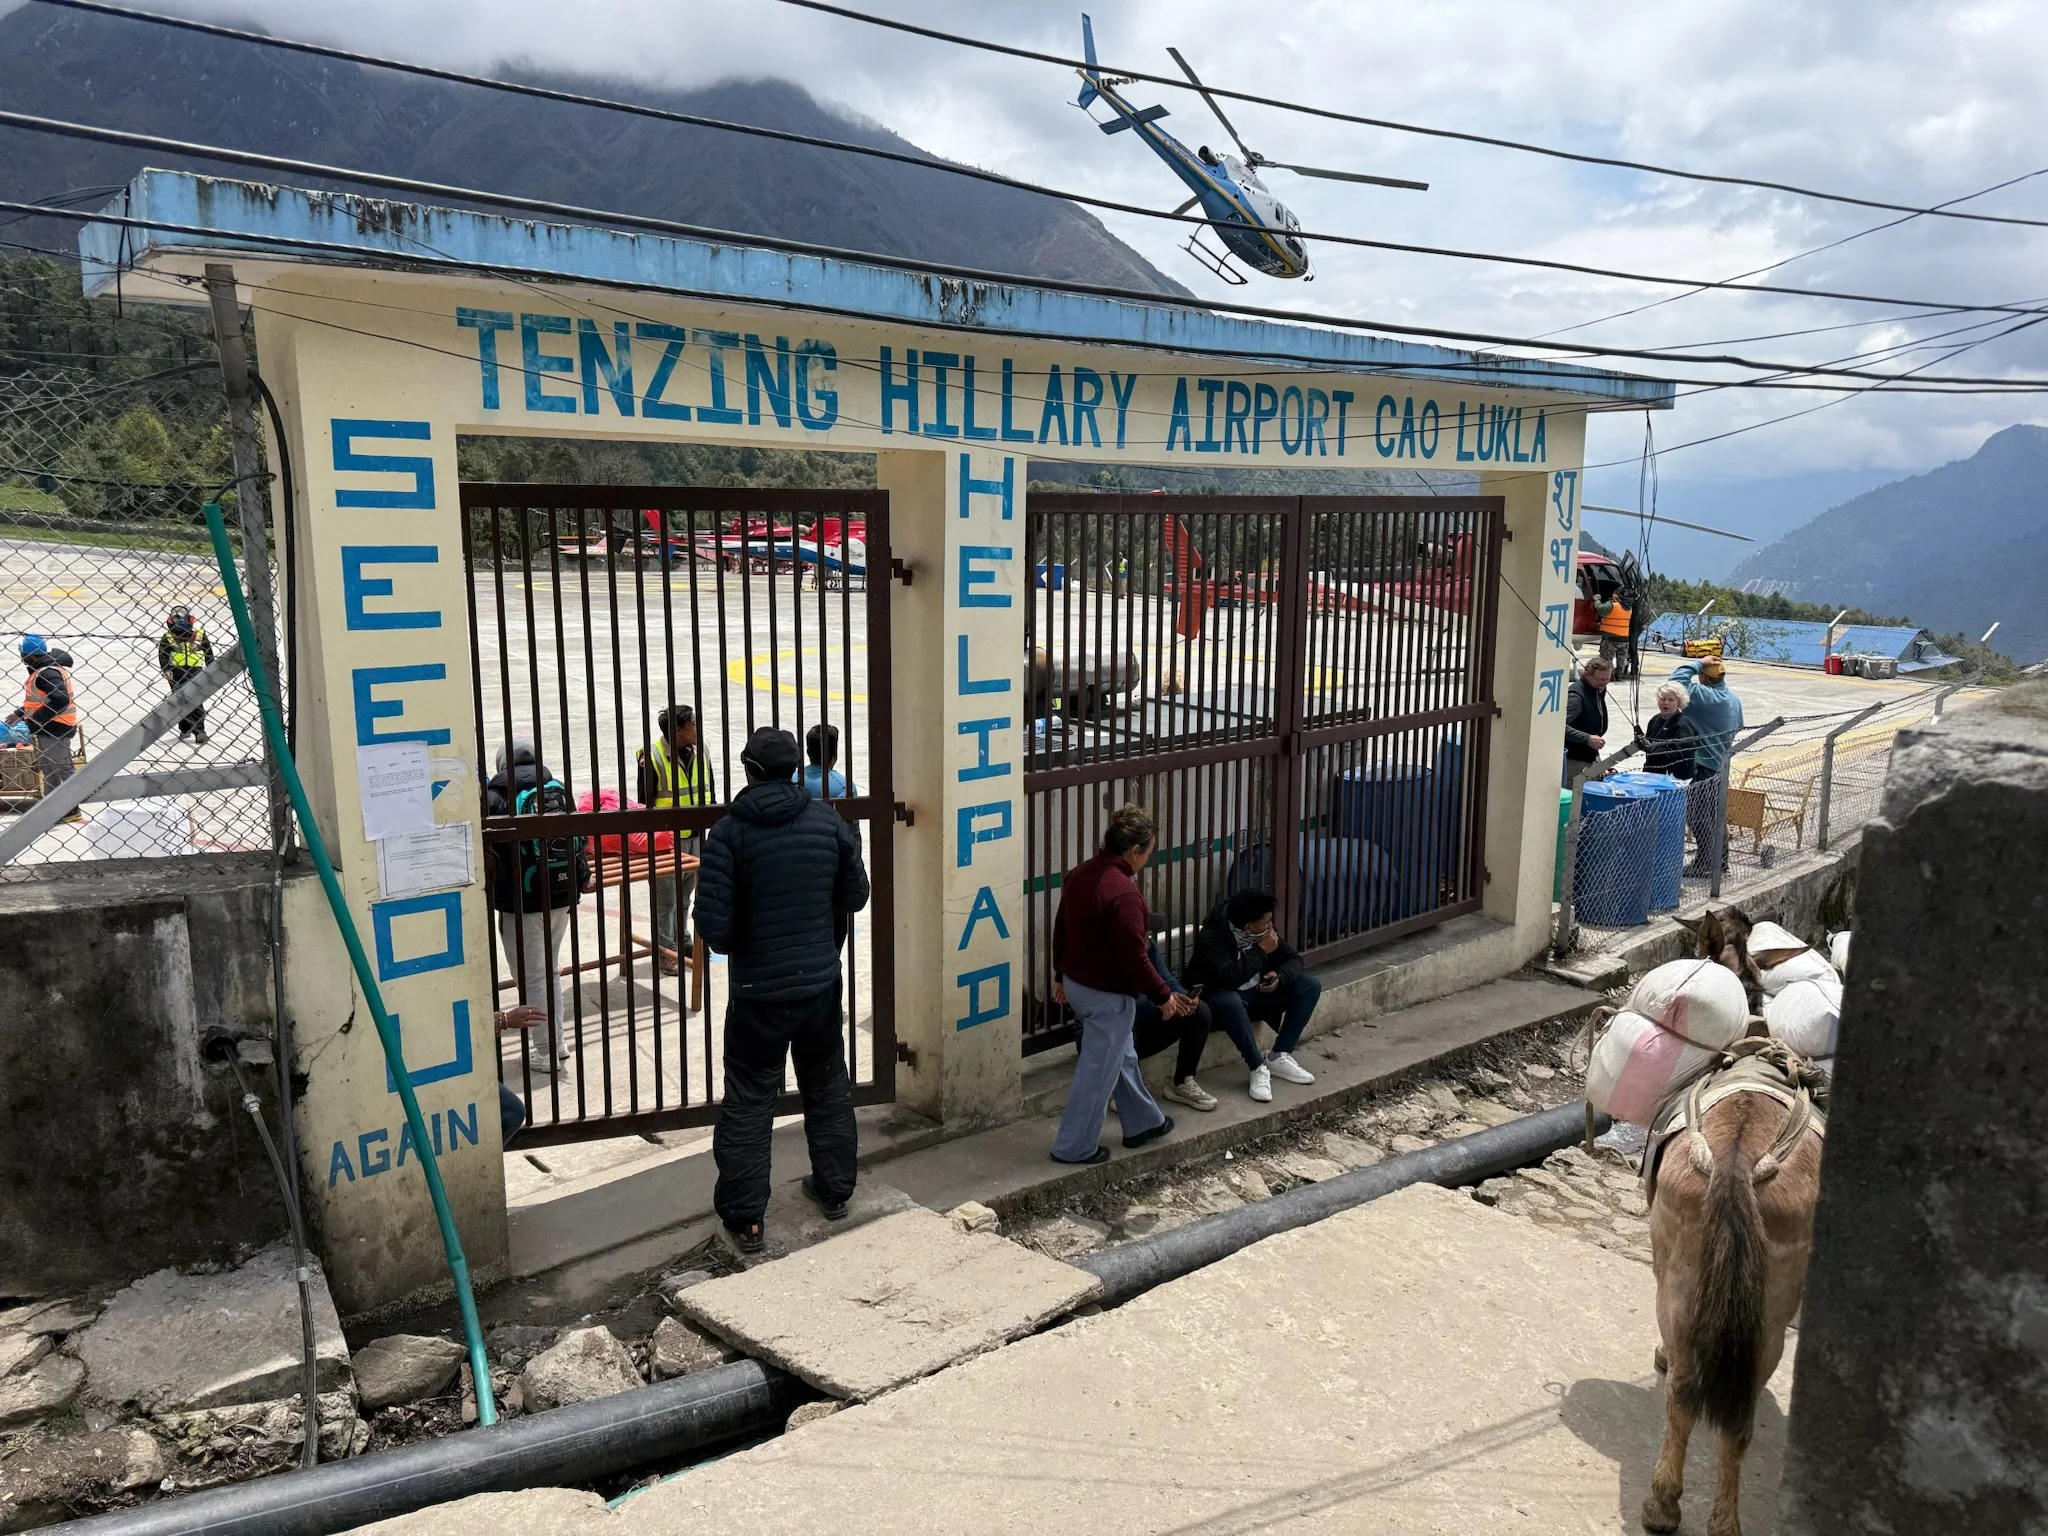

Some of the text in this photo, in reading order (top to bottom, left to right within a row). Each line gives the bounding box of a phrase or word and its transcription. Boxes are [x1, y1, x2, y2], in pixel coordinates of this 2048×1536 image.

[456, 306, 1546, 463] TENZING HILLARY AIRPORT CAO LUKLA
[331, 418, 451, 746] SEE
[956, 453, 1013, 1032] HELIPAD
[370, 779, 473, 1093] OU
[328, 1102, 479, 1189] AGAIN
